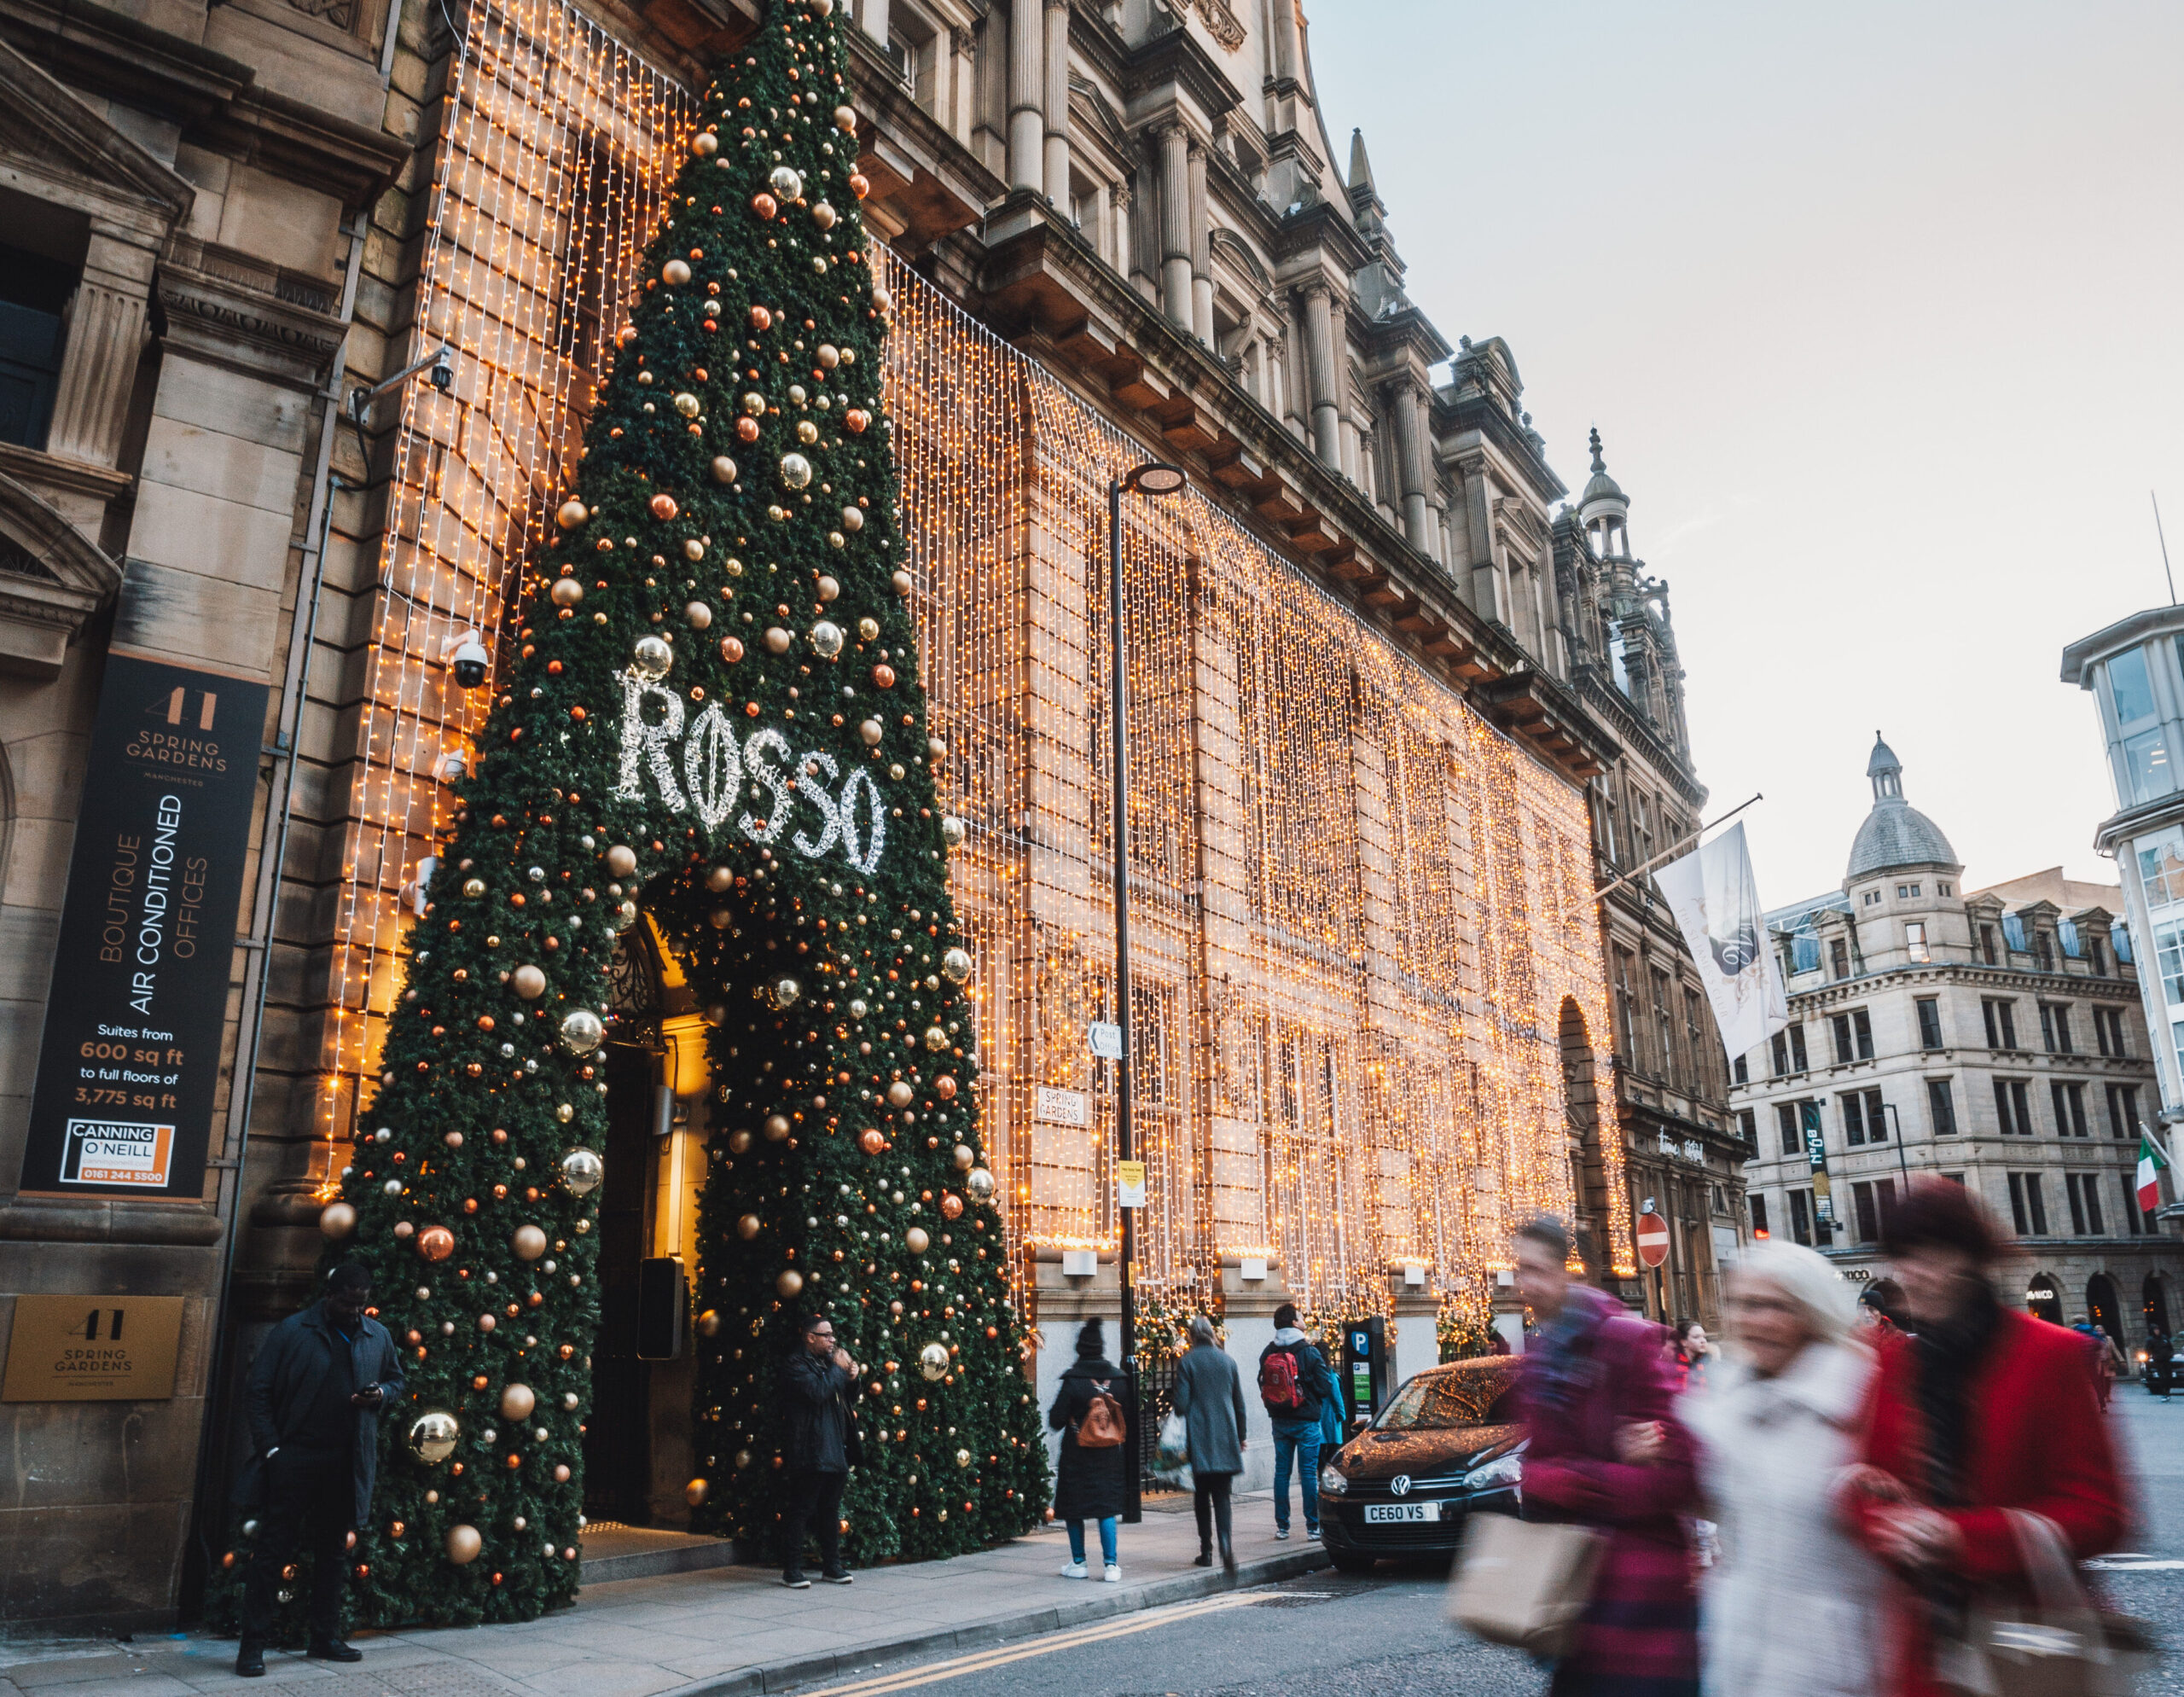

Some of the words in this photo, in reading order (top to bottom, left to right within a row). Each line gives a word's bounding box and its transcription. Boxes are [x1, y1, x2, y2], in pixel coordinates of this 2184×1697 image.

[145, 686, 218, 731] 41
[139, 730, 218, 756] SPRING
[127, 744, 227, 771] GARDENS
[607, 663, 887, 875] ROSSO
[136, 794, 181, 965] CONDITIONED
[100, 833, 141, 963] BOUTIQUE
[174, 857, 207, 959] OFFICES
[130, 972, 156, 1015] AIR
[97, 1024, 137, 1038] Suites
[142, 1027, 173, 1041] from
[1101, 1028, 1116, 1039] Post
[80, 1042, 127, 1061] 600
[134, 1049, 160, 1066] sq
[166, 1049, 183, 1066] ft
[80, 1067, 96, 1078] to
[99, 1068, 119, 1080] full
[123, 1070, 160, 1084] floors
[164, 1073, 179, 1085] of
[75, 1087, 127, 1105] 3,775
[132, 1095, 155, 1109] sq
[161, 1093, 177, 1108] ft
[1045, 1090, 1077, 1107] SPRING
[1039, 1104, 1078, 1121] GARDENS
[73, 1124, 153, 1141] CANNING
[85, 1142, 152, 1157] O'NEILL
[84, 1170, 107, 1179] 0161
[110, 1171, 131, 1180] 244
[134, 1171, 163, 1182] 5500
[68, 1309, 125, 1340] 41
[1356, 1334, 1366, 1351] P
[64, 1349, 126, 1360] SPRING
[54, 1361, 133, 1372] GARDENS
[1370, 1506, 1403, 1520] CE60
[1407, 1505, 1433, 1520] VS
